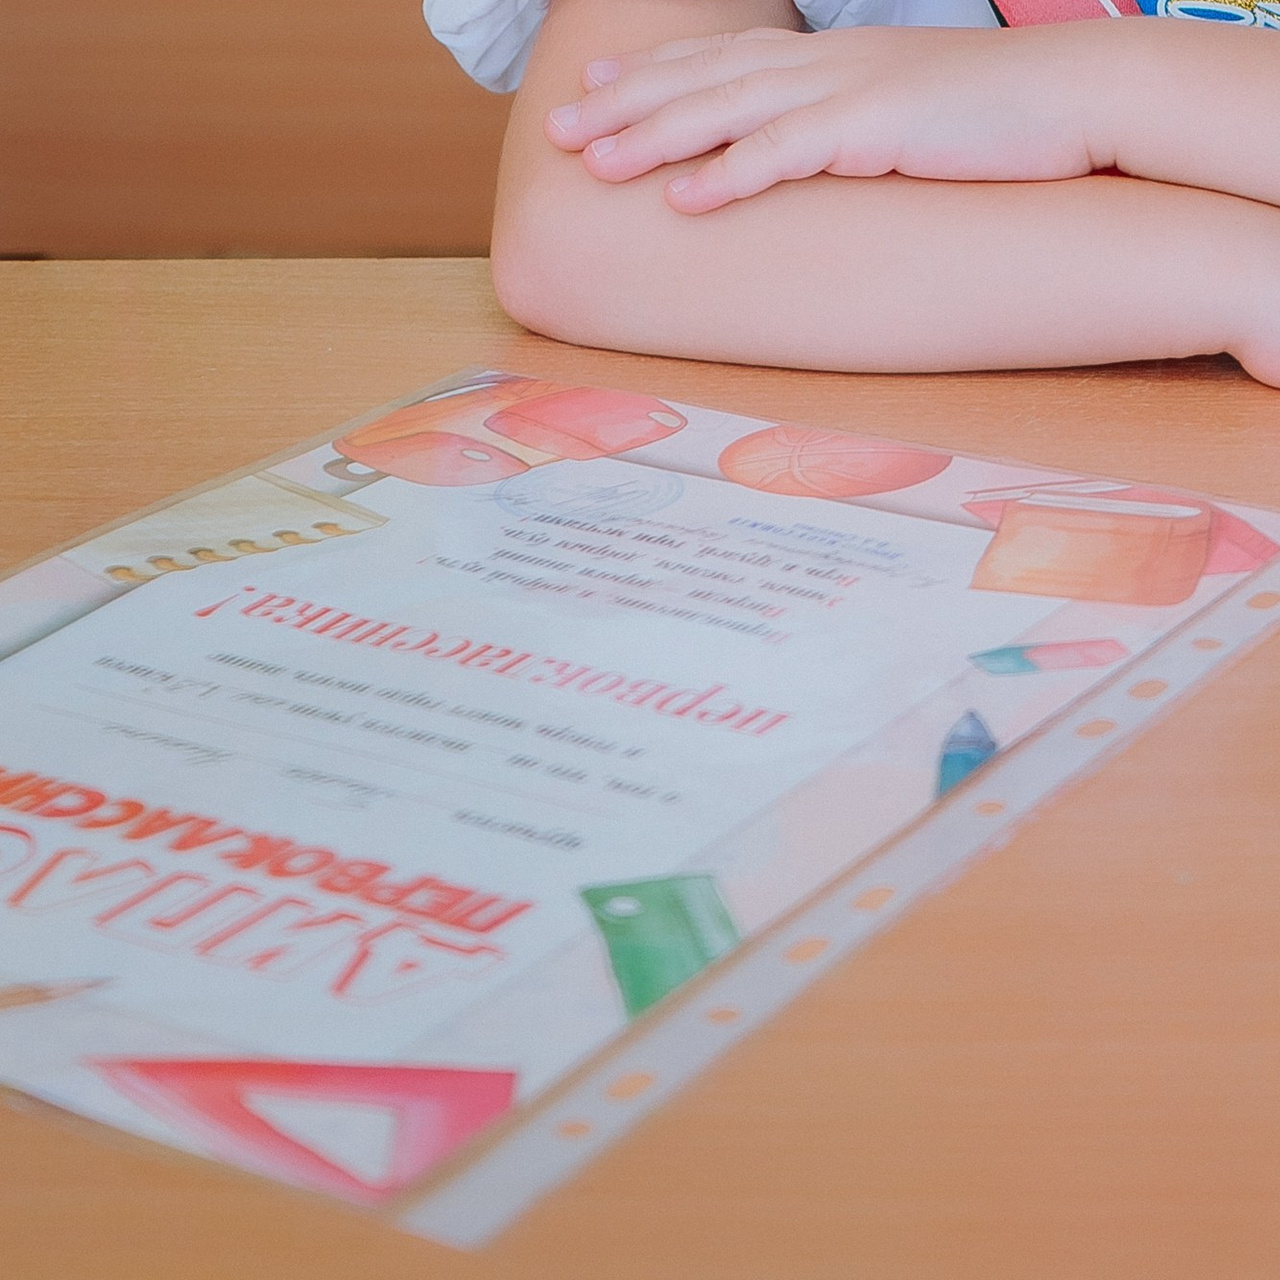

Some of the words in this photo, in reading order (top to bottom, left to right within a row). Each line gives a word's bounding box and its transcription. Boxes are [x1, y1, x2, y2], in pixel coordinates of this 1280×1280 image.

[518, 511, 629, 538] мечтами!
[552, 538, 648, 562] добрым
[629, 531, 687, 550] гори
[416, 552, 486, 574] путь!
[690, 544, 776, 568] друзей,
[481, 568, 577, 594] добрый
[653, 555, 745, 584] смелым,
[803, 567, 862, 588] Верь
[684, 586, 788, 618] Впереди
[757, 579, 845, 608] Умным,
[194, 584, 792, 738] первоклассника!
